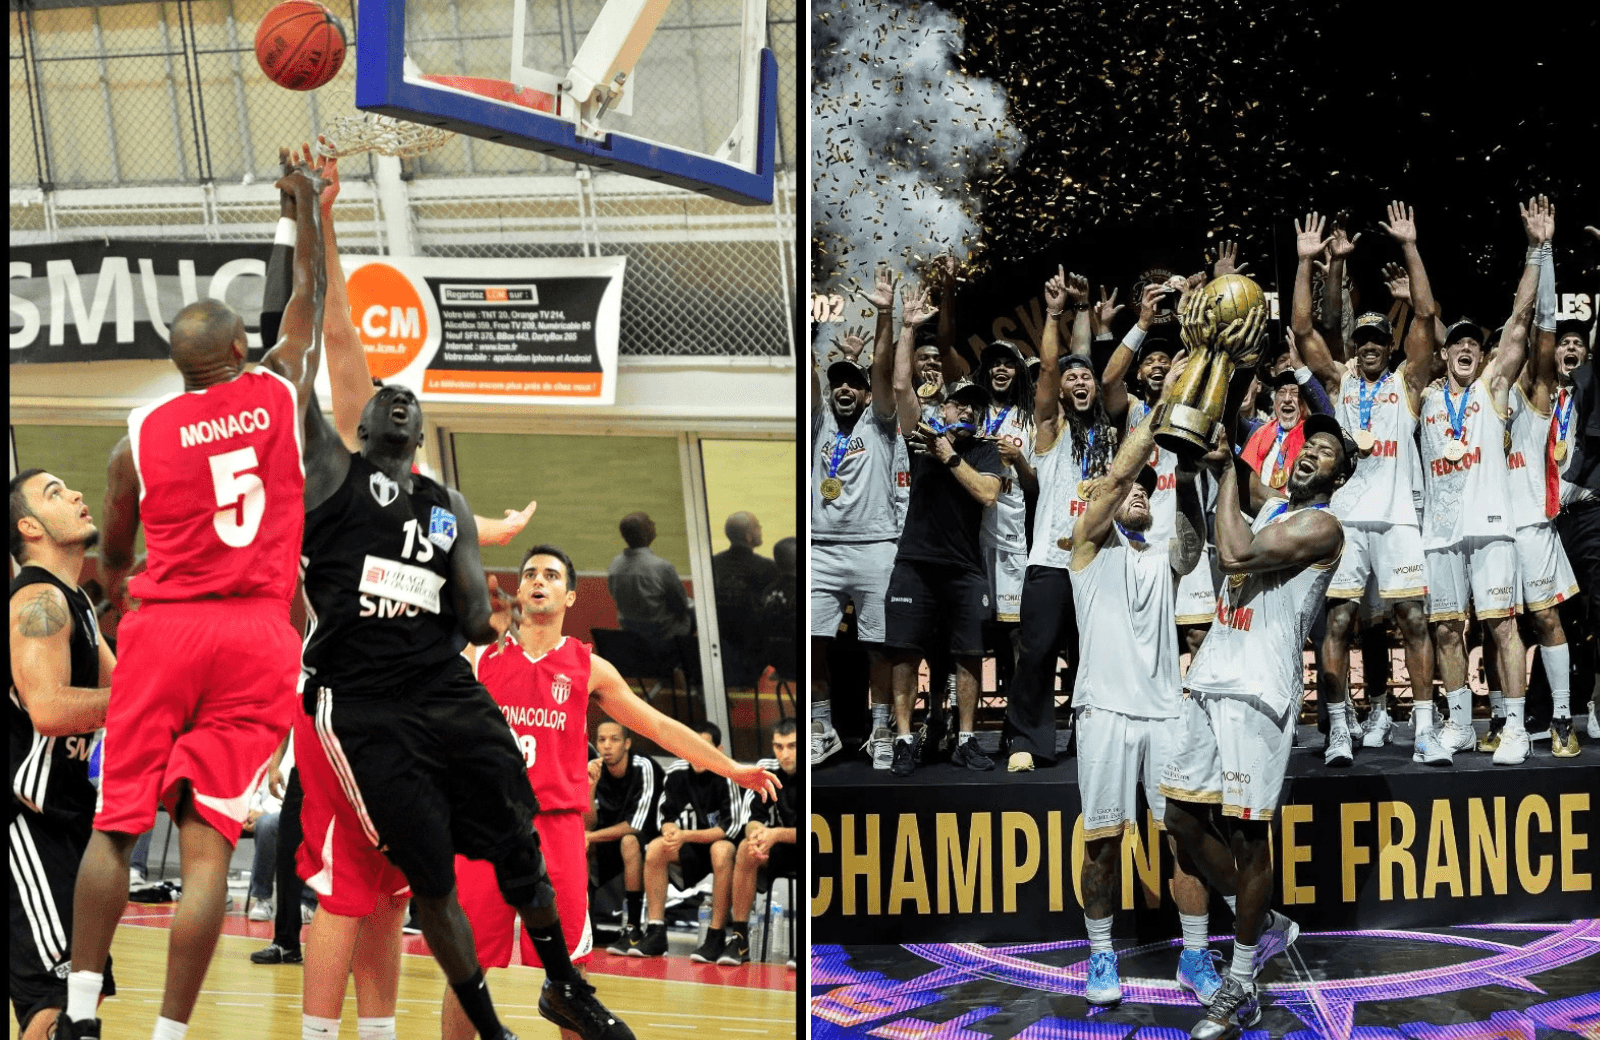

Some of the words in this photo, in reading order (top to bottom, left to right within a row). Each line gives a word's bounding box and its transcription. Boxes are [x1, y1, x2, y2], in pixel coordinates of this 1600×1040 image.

[10, 256, 267, 349] SMUC
[446, 289, 484, 300] Regardez
[509, 290, 523, 298] sur
[811, 293, 845, 322] 02
[356, 305, 420, 338] CM
[443, 310, 462, 318] Votre
[511, 311, 538, 320] Orange
[551, 311, 565, 320] 214,
[445, 321, 475, 329] AliceBox
[511, 321, 521, 329] TV
[445, 341, 473, 350] Internet
[446, 331, 463, 339] Neuf
[465, 331, 480, 339] SFR
[496, 332, 515, 340] BBox
[532, 332, 563, 342] DartyBox
[444, 352, 463, 360] Votre
[464, 353, 487, 361] mobile
[493, 353, 531, 363] application
[556, 354, 564, 362] et
[564, 354, 592, 363] Android
[179, 406, 271, 448] MONACO
[208, 446, 266, 548] 5
[401, 518, 434, 563] 15
[498, 705, 567, 732] ONACOLOR
[811, 809, 1176, 918] CHAMPIN
[1340, 792, 1593, 903] FRANCE
